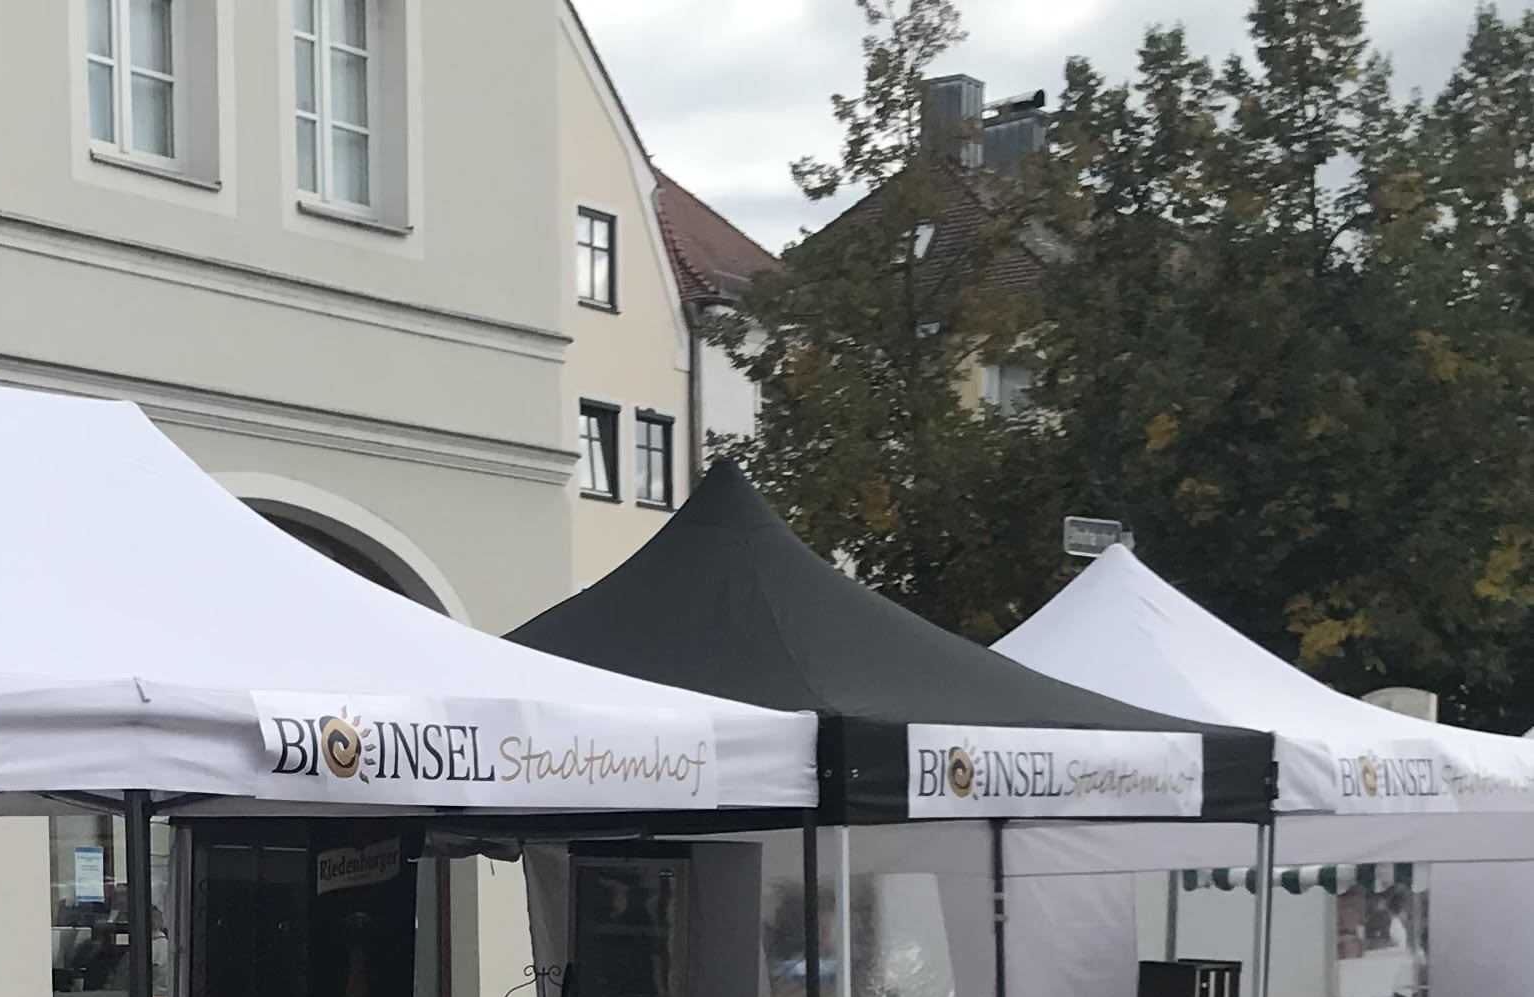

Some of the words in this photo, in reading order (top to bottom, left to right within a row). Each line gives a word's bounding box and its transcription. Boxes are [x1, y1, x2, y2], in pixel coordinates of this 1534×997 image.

[373, 720, 496, 782] INSEL
[499, 736, 708, 796] Stadtamhof
[980, 751, 1062, 798] INSEL
[1383, 758, 1440, 797] INSEL
